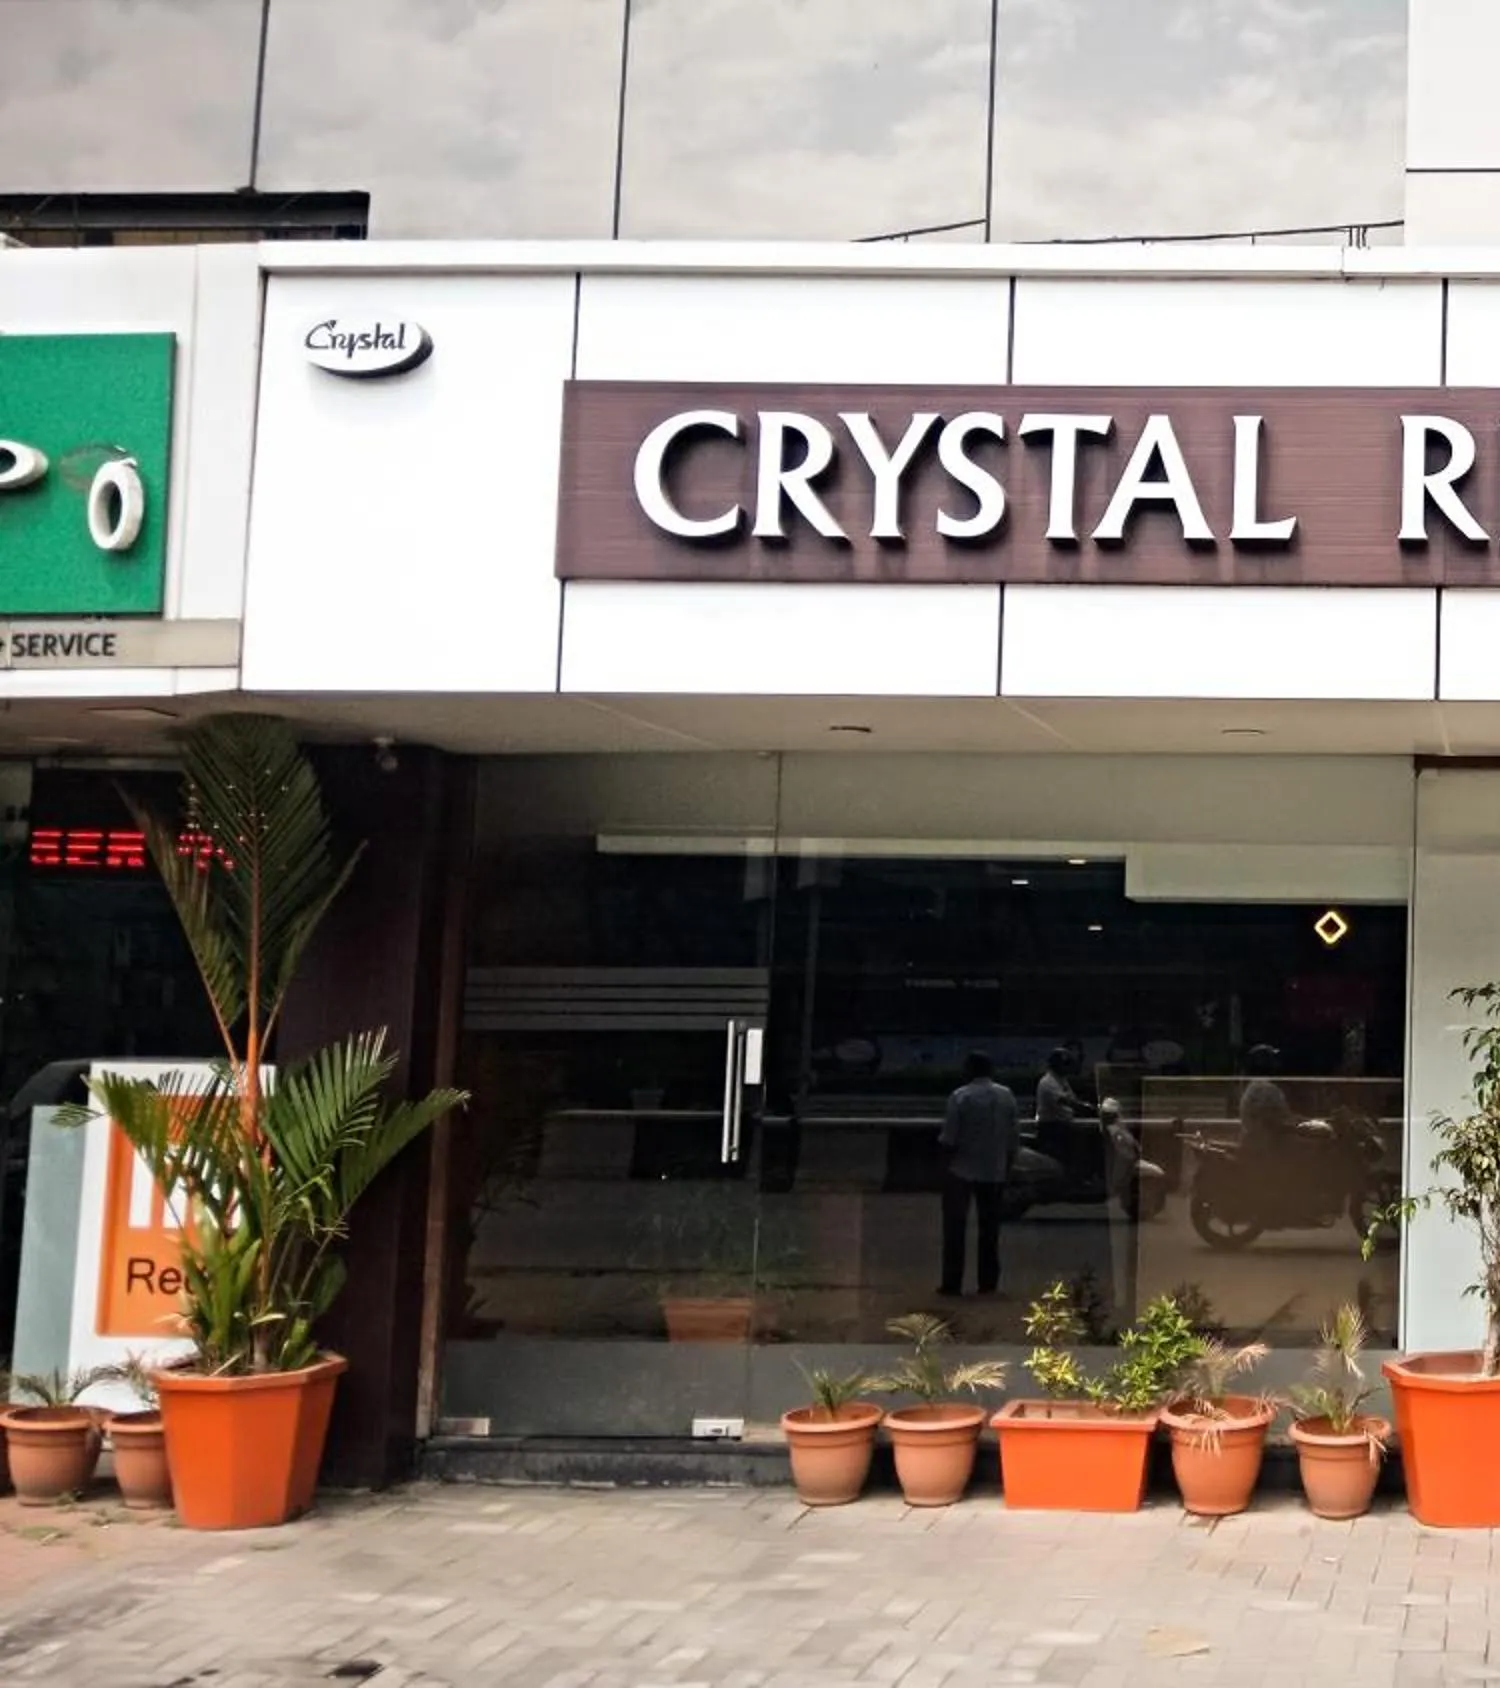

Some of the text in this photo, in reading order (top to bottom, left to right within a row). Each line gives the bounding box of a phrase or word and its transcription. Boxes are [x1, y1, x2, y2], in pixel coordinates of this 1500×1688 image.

[304, 319, 406, 359] Crystal
[633, 409, 1298, 545] CRYSTAL
[11, 632, 117, 657] SERVICE
